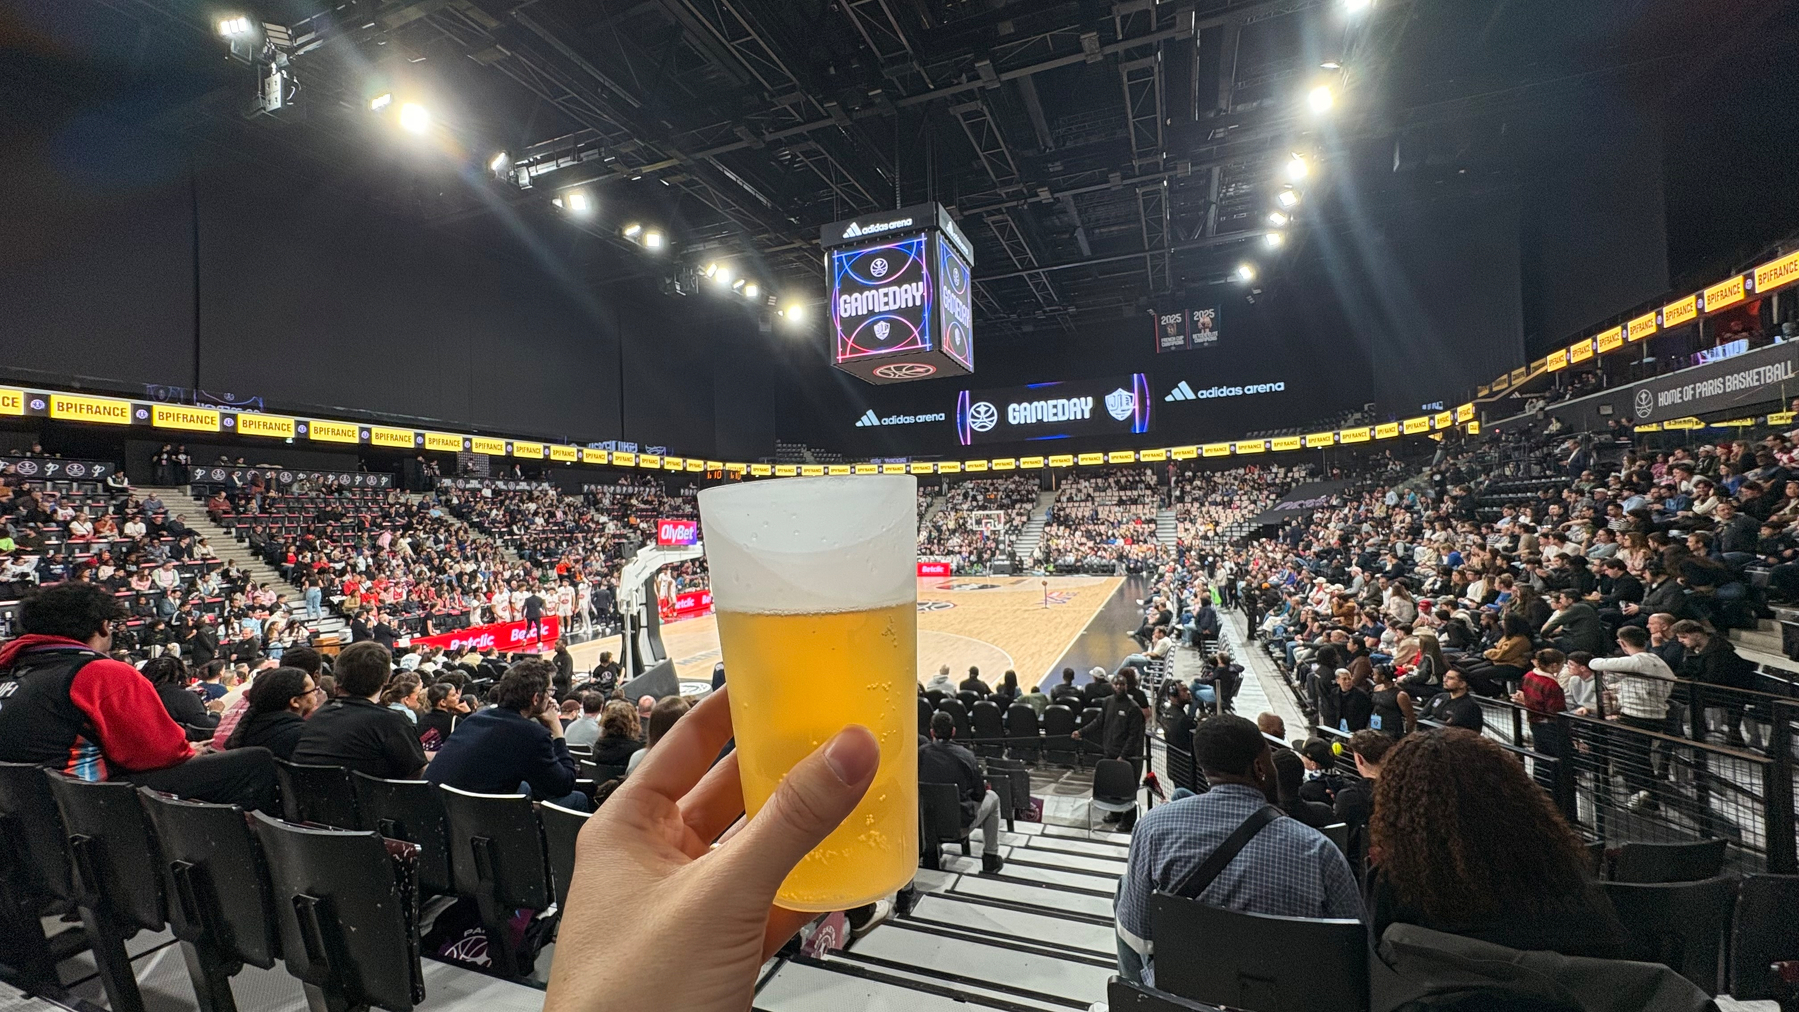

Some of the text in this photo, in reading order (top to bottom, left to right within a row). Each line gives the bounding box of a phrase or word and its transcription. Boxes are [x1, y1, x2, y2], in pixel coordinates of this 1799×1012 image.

[861, 218, 913, 235] adidas arena
[1758, 259, 1799, 286] BPIFRANCE
[840, 281, 924, 318] GAMEDAY
[1707, 283, 1741, 305] BPIFRANCE
[1161, 313, 1182, 325] 2025
[1665, 302, 1694, 322] BPIFRANCE
[1197, 381, 1285, 399] adidas arena
[1658, 360, 1795, 407] HOME OF PARIS BASKETBALL
[2, 396, 19, 408] CE
[57, 402, 127, 417] BPIFRANCE
[158, 411, 216, 426] BPIFRANCE
[881, 412, 945, 425] adidas arena
[1007, 396, 1094, 426] GAMEDAY
[242, 419, 292, 432] BPIFRANCE
[313, 426, 356, 438] BPIFRANCE
[375, 432, 412, 443] BPIFRANCE
[428, 437, 461, 447] BPIFRANCE
[661, 524, 694, 543] OlyBet
